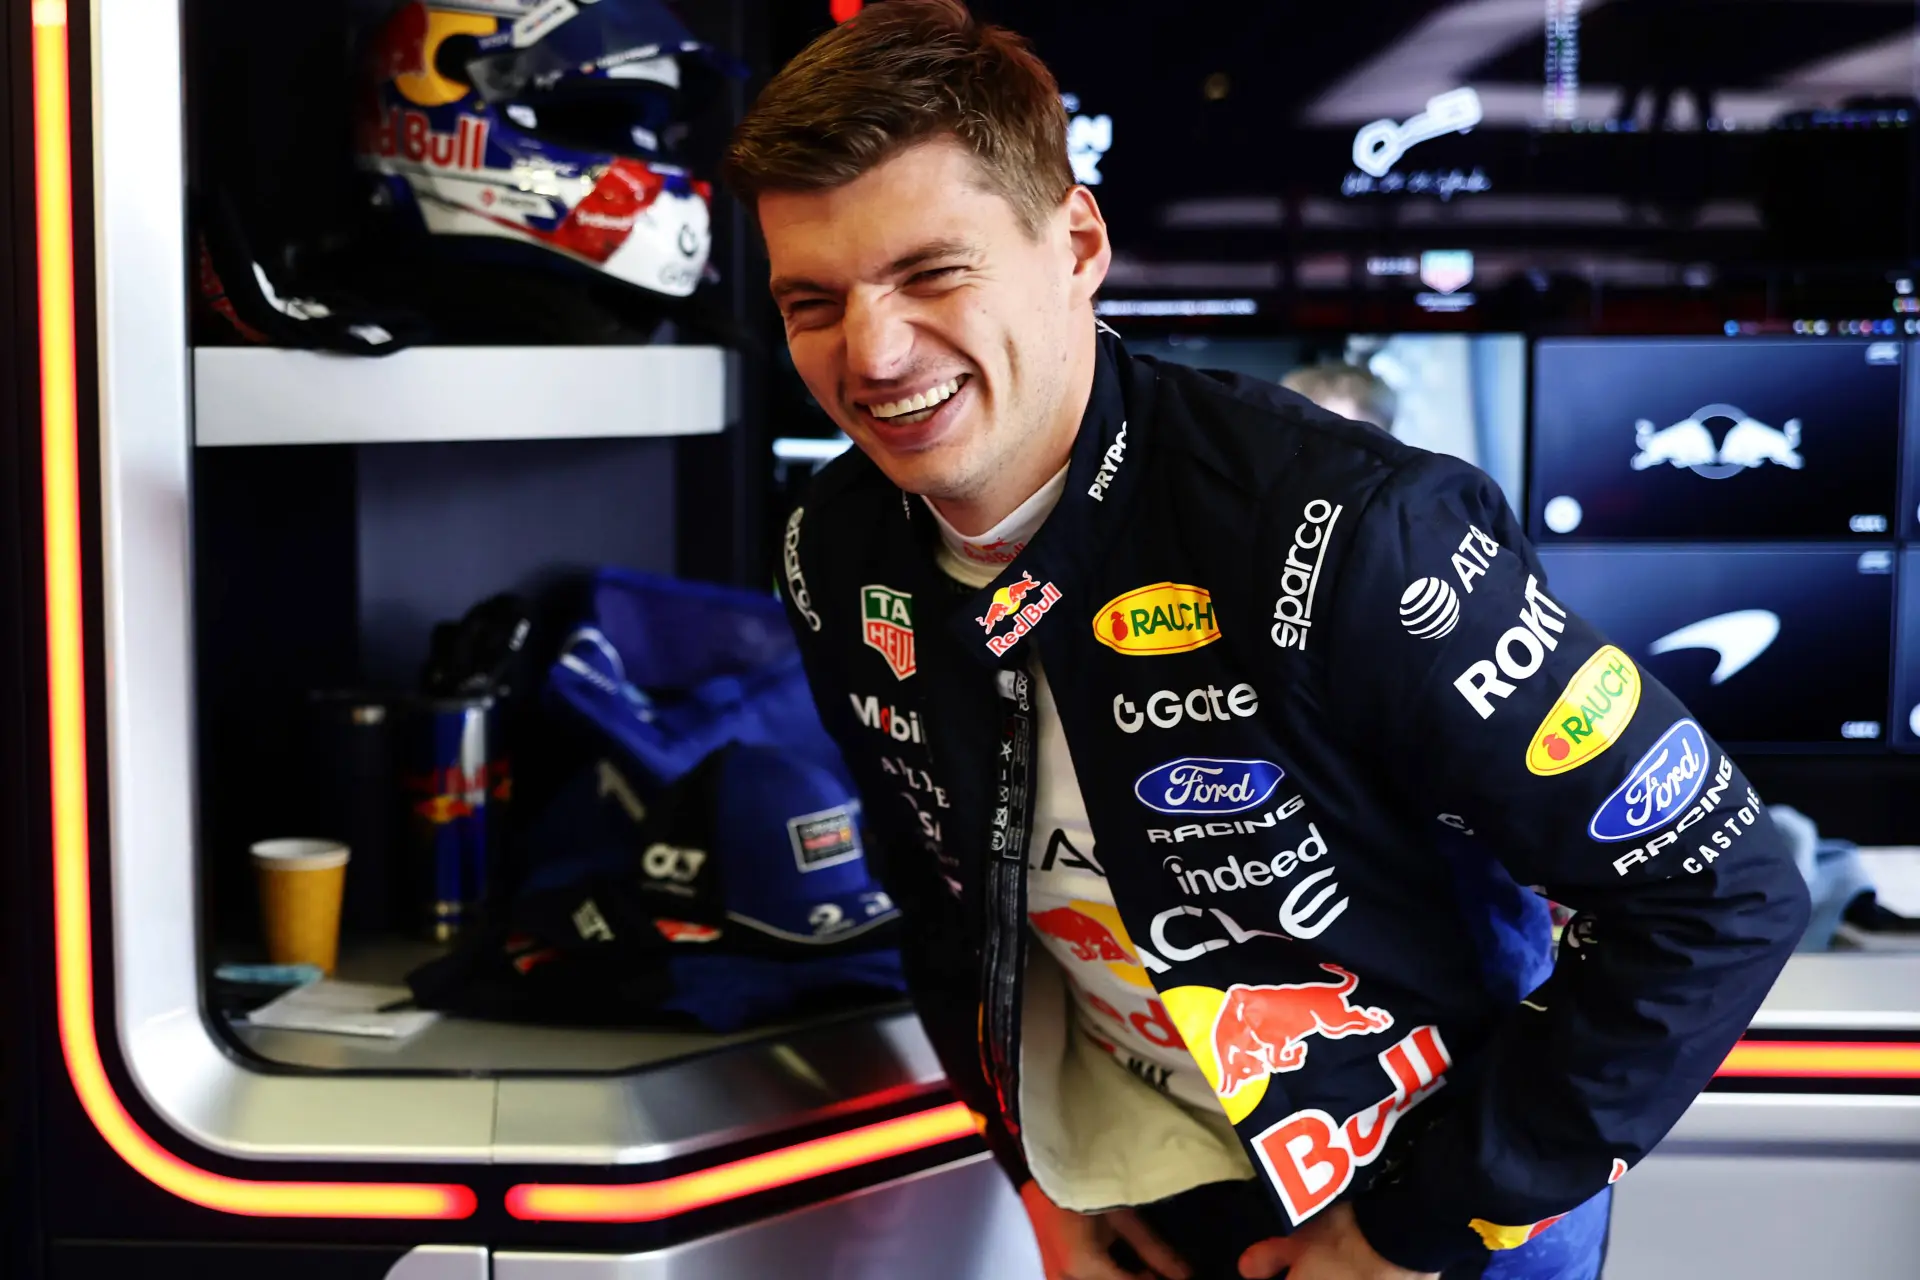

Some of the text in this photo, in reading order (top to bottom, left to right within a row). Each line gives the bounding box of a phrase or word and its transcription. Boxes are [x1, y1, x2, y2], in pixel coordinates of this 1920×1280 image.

[402, 110, 490, 172] Bull
[1088, 421, 1127, 502] PRYPC
[869, 591, 912, 626] TA
[1270, 499, 1343, 651] sparco
[985, 581, 1063, 658] Red Bull
[1130, 602, 1214, 637] RAUCH
[1453, 573, 1566, 720] ROKT
[1146, 683, 1259, 729] Gate
[1561, 655, 1632, 744] RAUCH
[1146, 794, 1306, 843] RACING
[1164, 764, 1255, 806] Ford
[1612, 755, 1733, 877] RACING
[1625, 737, 1700, 827] Ford
[1163, 822, 1328, 895] indeed
[1250, 1023, 1454, 1227] Bull
